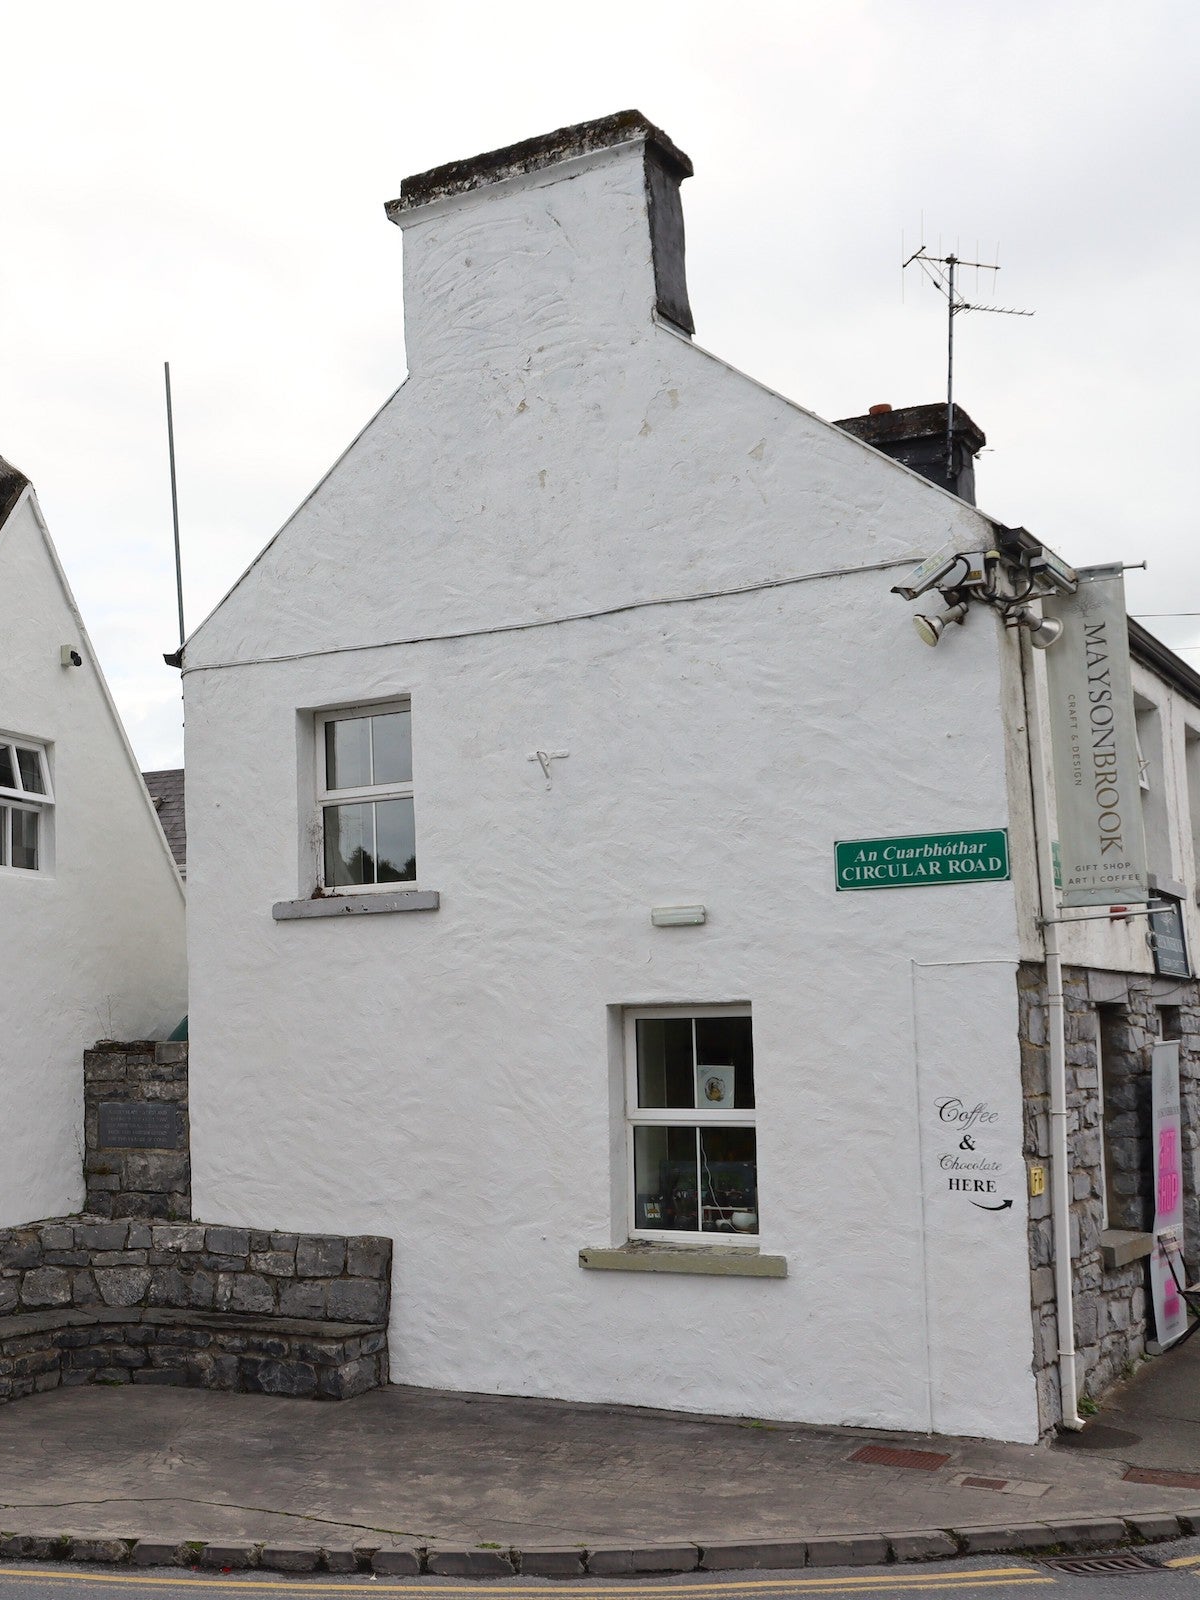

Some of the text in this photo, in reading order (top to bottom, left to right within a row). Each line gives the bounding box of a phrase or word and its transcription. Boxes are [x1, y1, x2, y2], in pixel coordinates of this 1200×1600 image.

[1067, 694, 1078, 729] CRAFT
[1083, 621, 1123, 855] MAYSONBROOK
[1072, 746, 1082, 786] DESIGN
[854, 841, 987, 863] An Cuarbhóthar
[841, 857, 1002, 881] CIRCULAR ROAD
[1075, 862, 1131, 872] GIFT SHOP
[1068, 873, 1141, 885] ART COFFEE
[934, 1096, 1000, 1131] Coffee
[959, 1134, 976, 1151] &
[937, 1152, 1003, 1171] Chocolate
[948, 1178, 998, 1193] HERE
